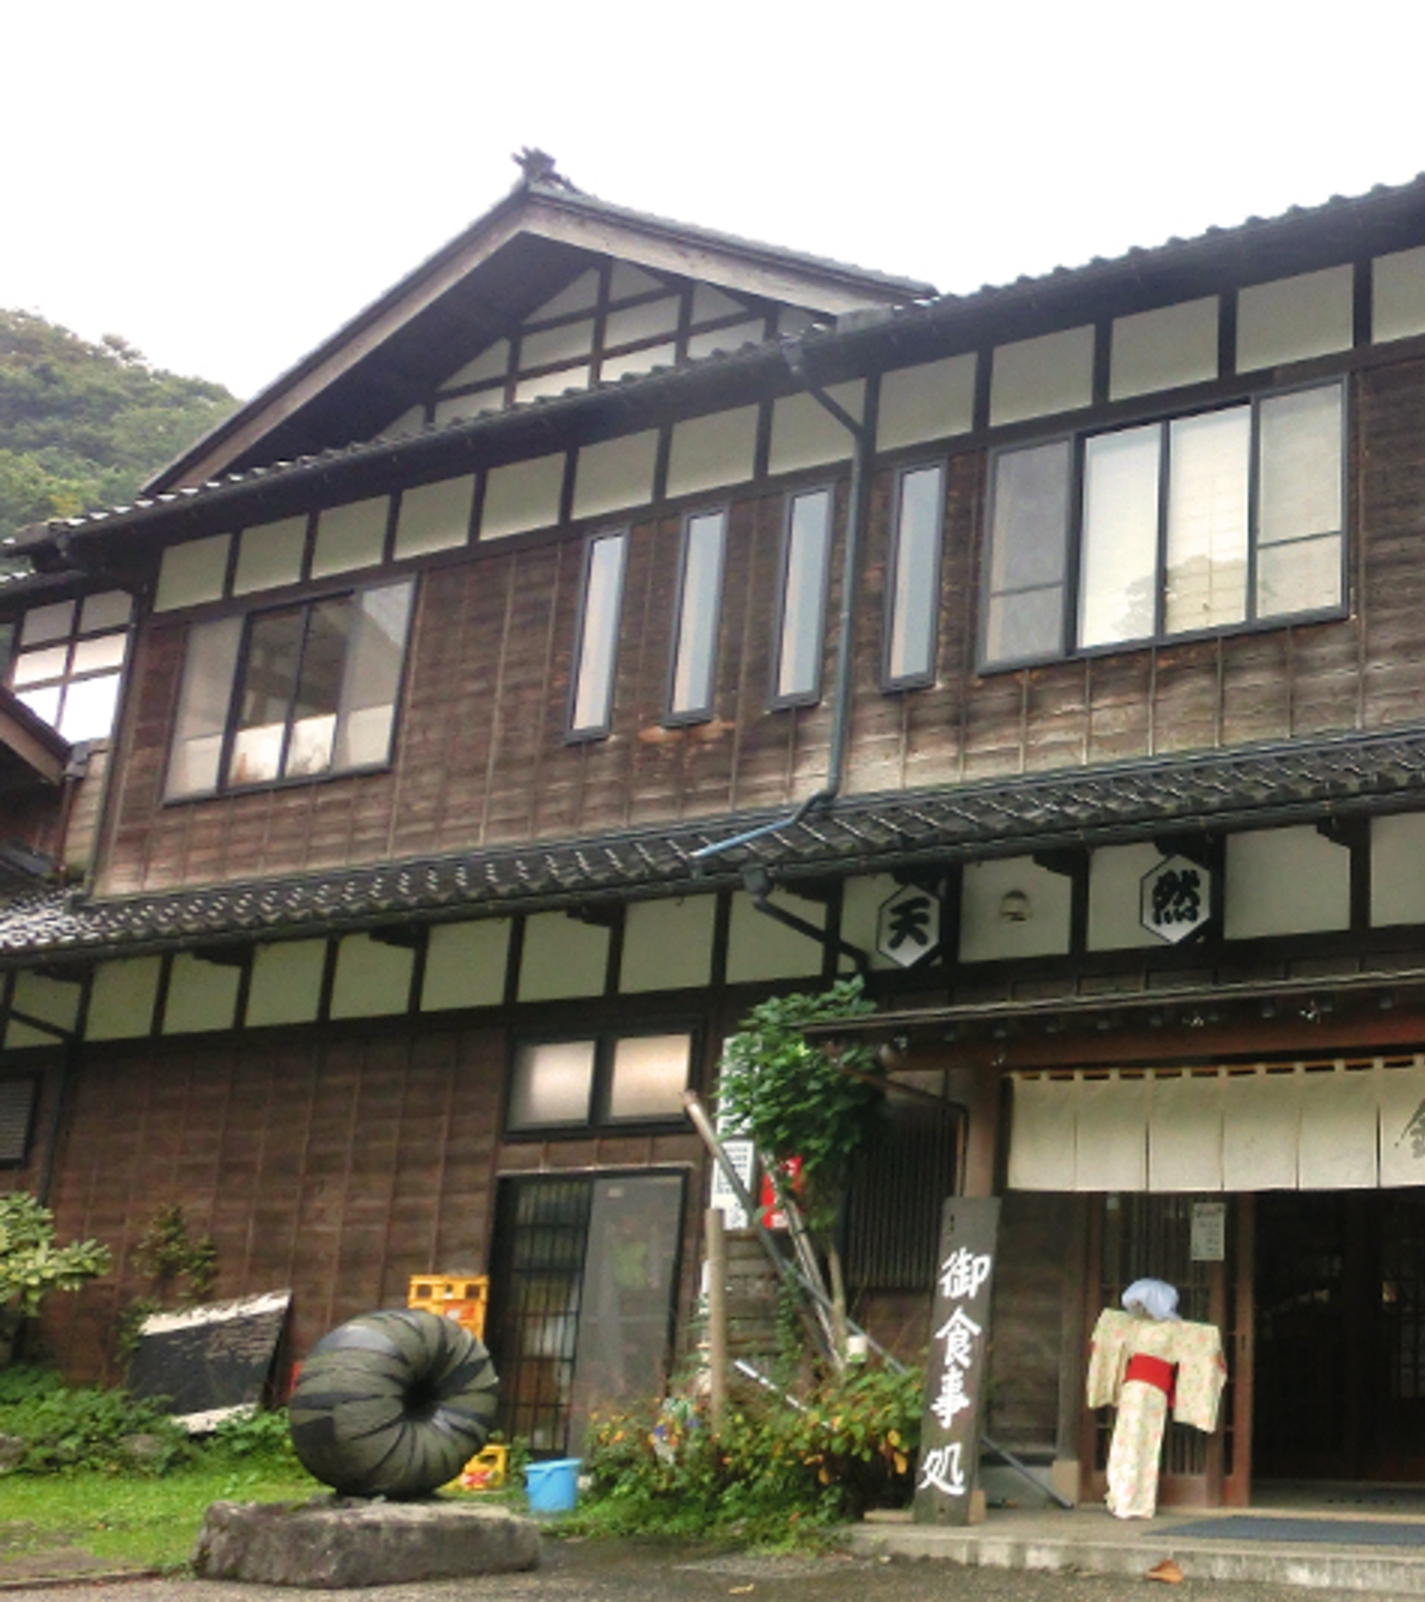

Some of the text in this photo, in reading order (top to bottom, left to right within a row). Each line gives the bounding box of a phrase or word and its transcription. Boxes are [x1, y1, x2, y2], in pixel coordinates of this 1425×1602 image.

[888, 896, 931, 949] 天
[1151, 869, 1201, 925] 然
[918, 1247, 993, 1496] 御食事処
